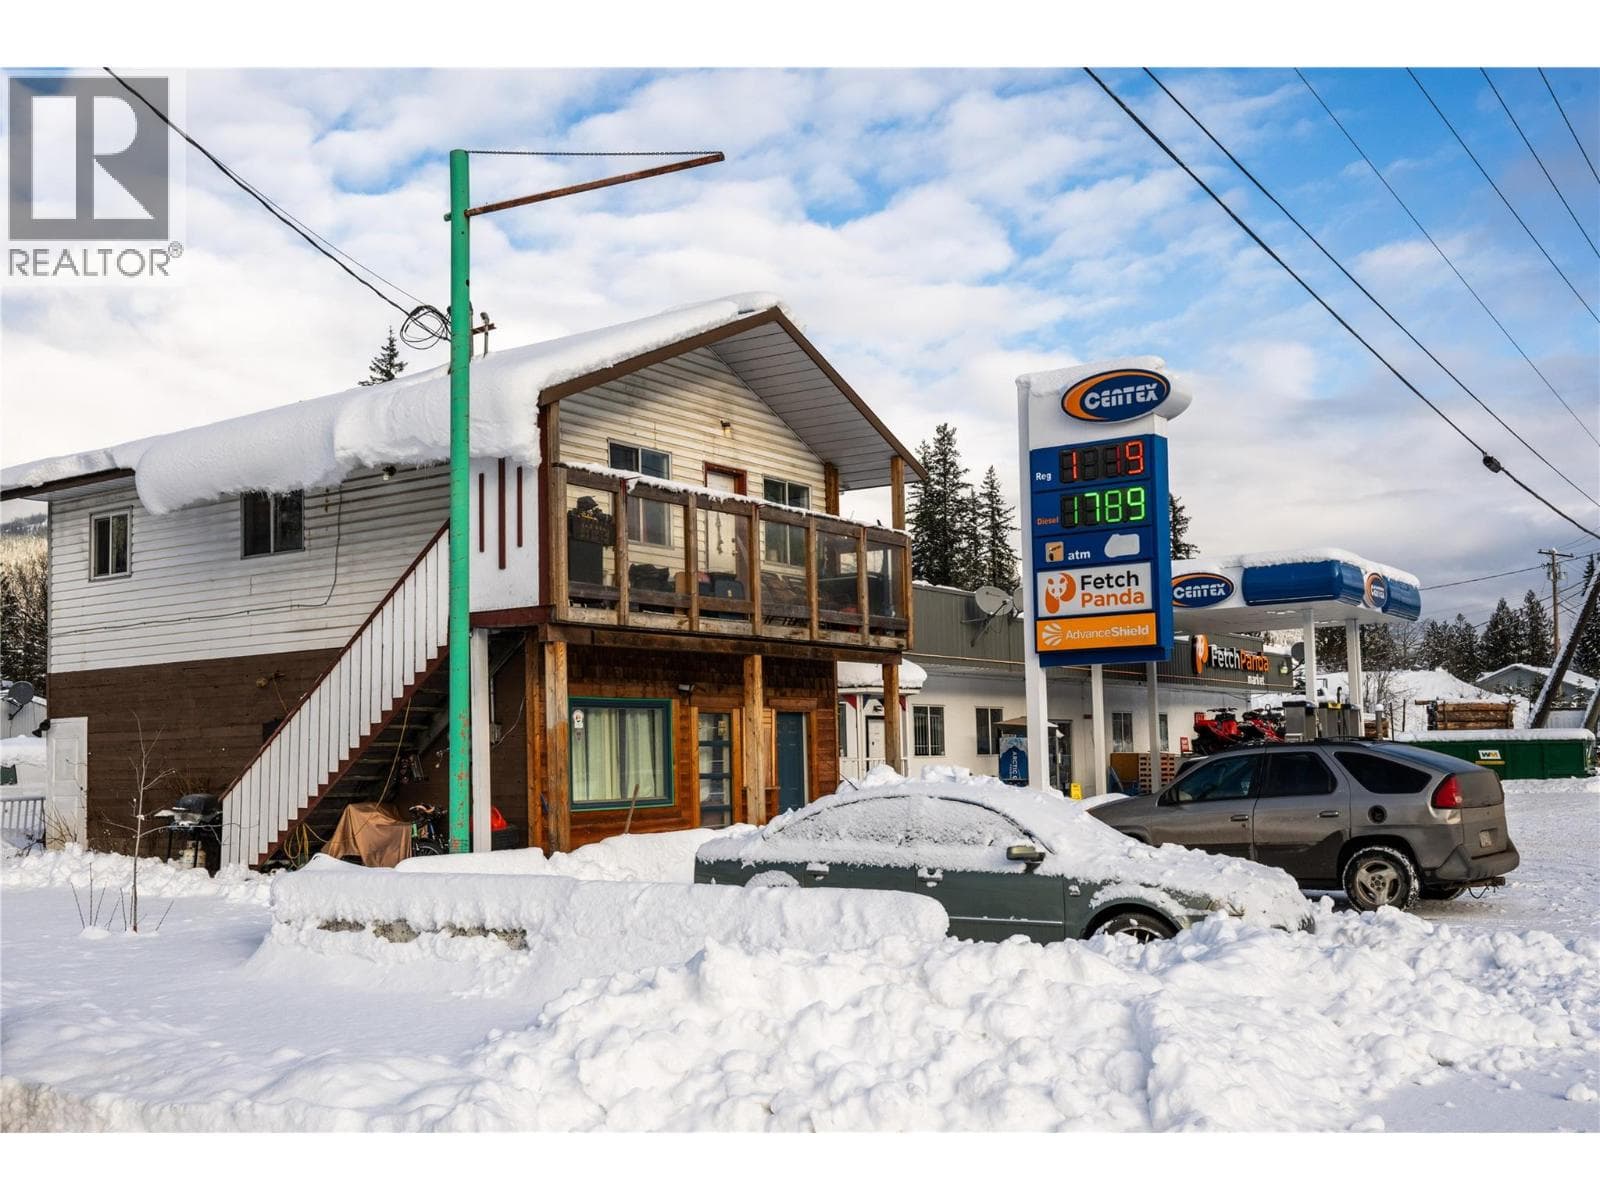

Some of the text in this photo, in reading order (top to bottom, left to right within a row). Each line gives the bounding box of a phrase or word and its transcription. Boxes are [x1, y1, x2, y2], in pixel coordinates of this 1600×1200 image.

[1084, 383, 1159, 410] CENTEX
[1036, 472, 1051, 481] Reg
[1074, 487, 1145, 525] 1789
[1037, 516, 1058, 525] Diesel
[1068, 550, 1091, 560] atm
[1080, 570, 1139, 591] Fetch
[1081, 588, 1145, 608] Panda
[1173, 583, 1226, 600] CENTEX
[1066, 624, 1149, 640] AdvanceShield
